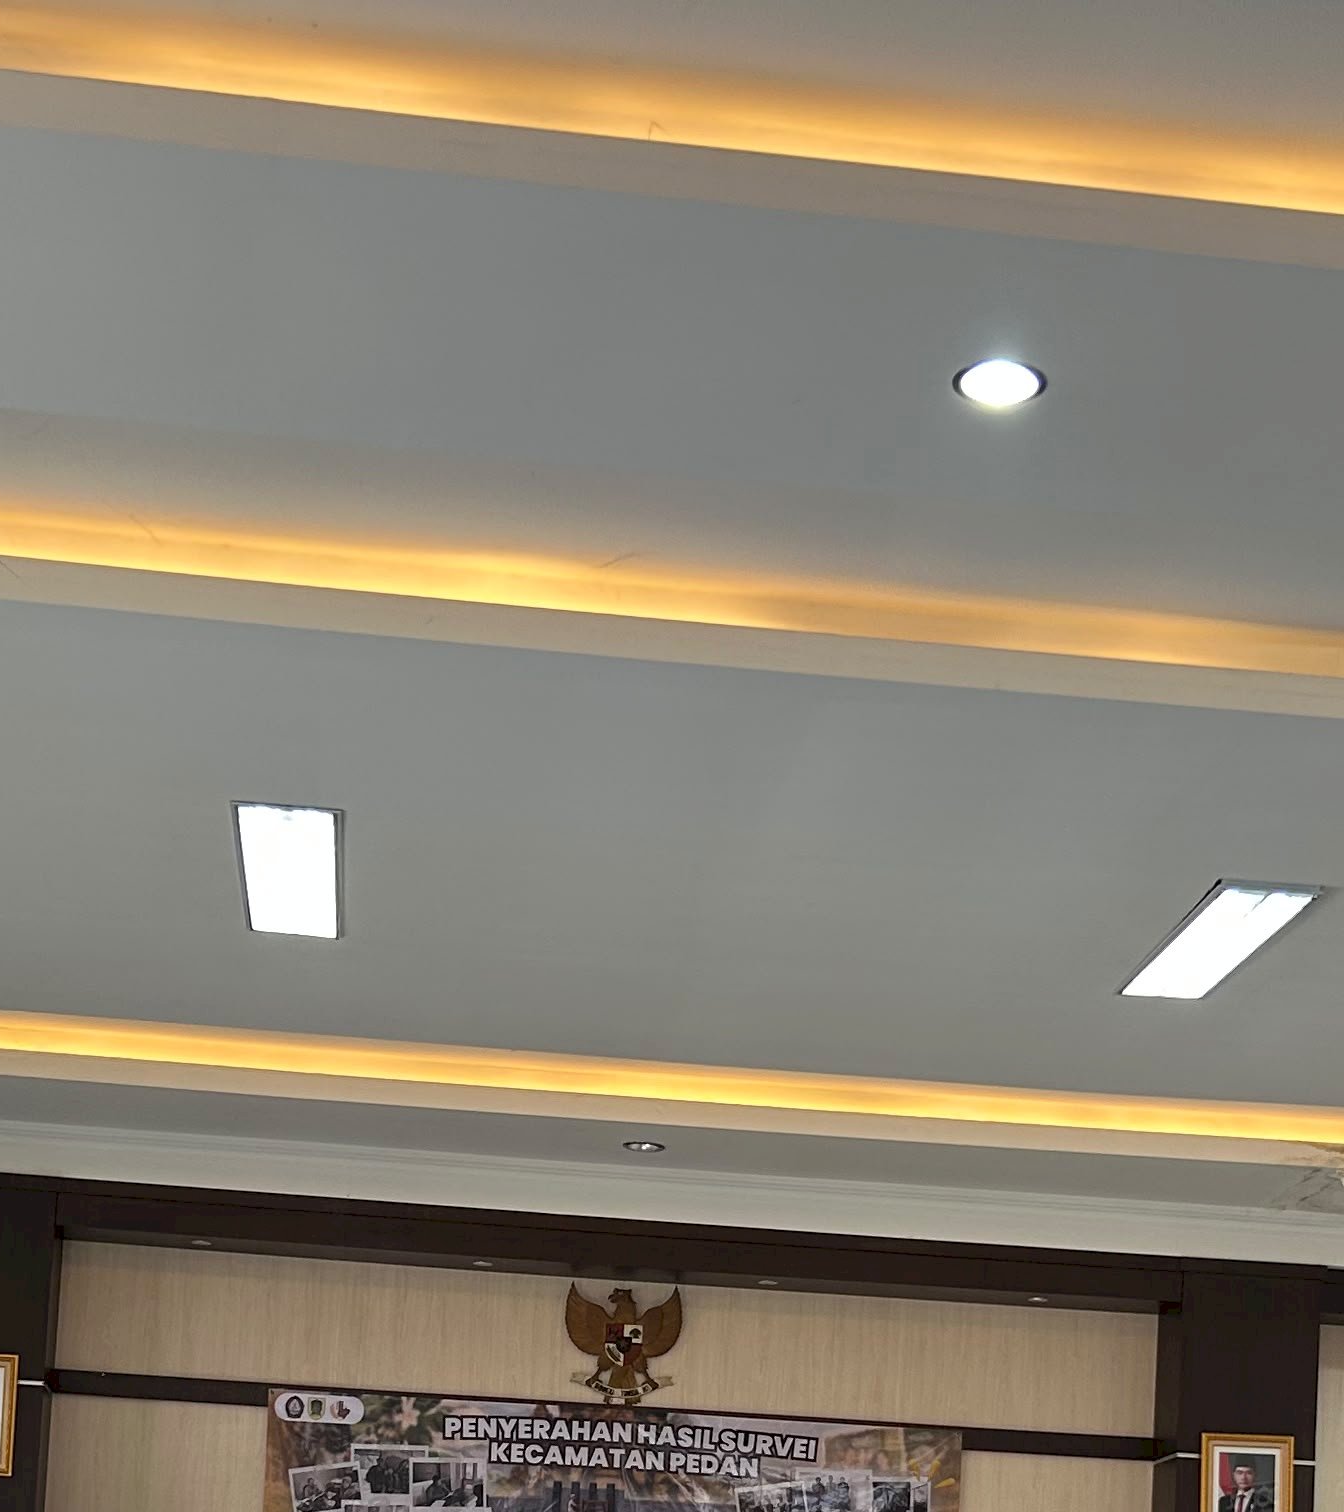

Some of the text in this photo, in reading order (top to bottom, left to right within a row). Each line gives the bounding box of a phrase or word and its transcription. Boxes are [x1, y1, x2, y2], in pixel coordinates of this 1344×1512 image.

[443, 1416, 819, 1461] PENYERAHAN HASIL SURVEI
[489, 1441, 760, 1478] KECAMATAN PEDAN
